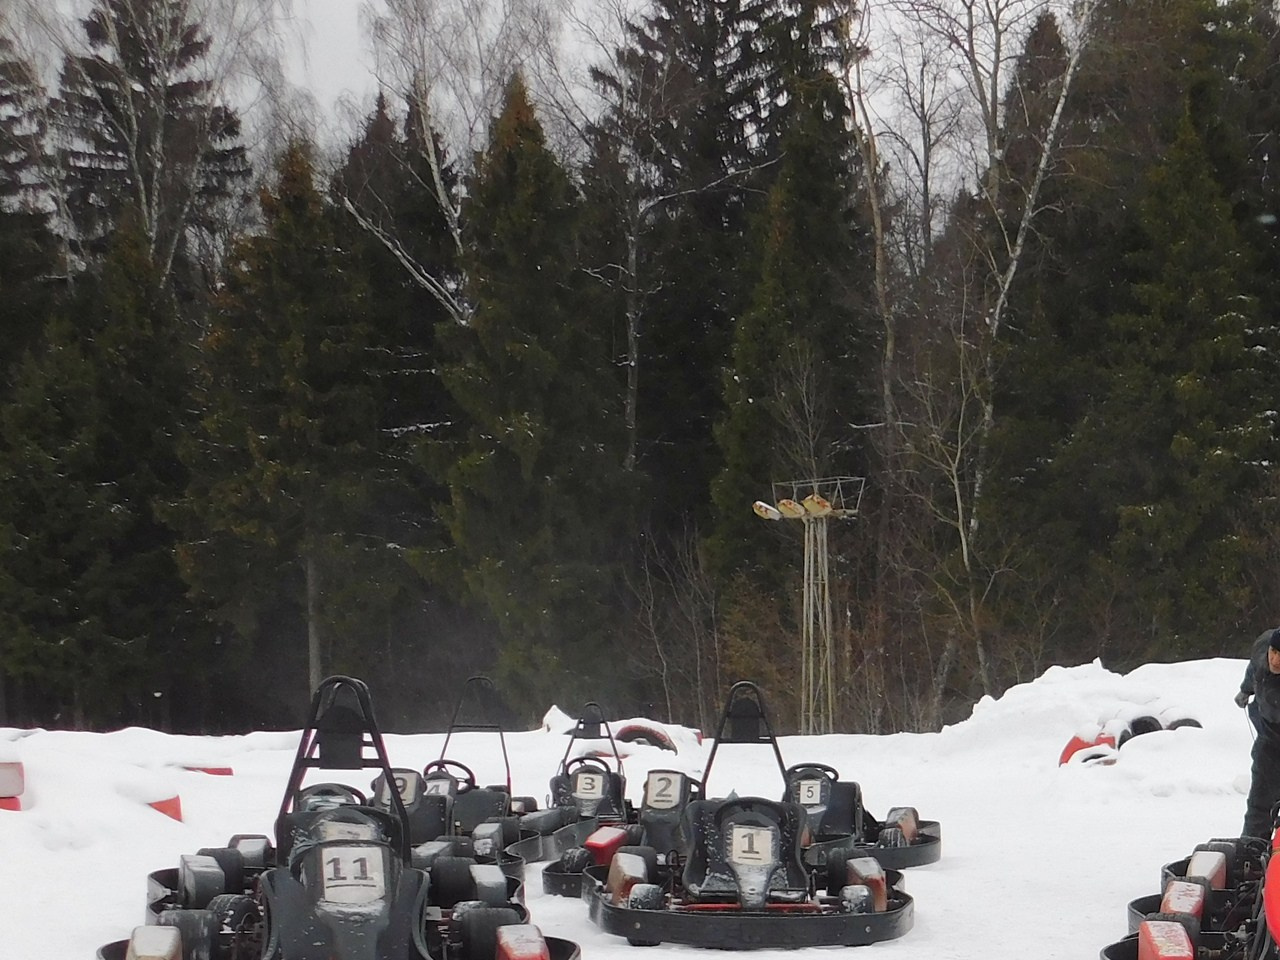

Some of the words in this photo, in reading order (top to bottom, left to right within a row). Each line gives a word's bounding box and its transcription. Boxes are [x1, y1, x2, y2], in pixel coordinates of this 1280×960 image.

[582, 777, 596, 790] 3
[655, 777, 673, 797] 2
[806, 786, 815, 799] 5
[741, 833, 760, 854] 1
[326, 857, 375, 881] 11
